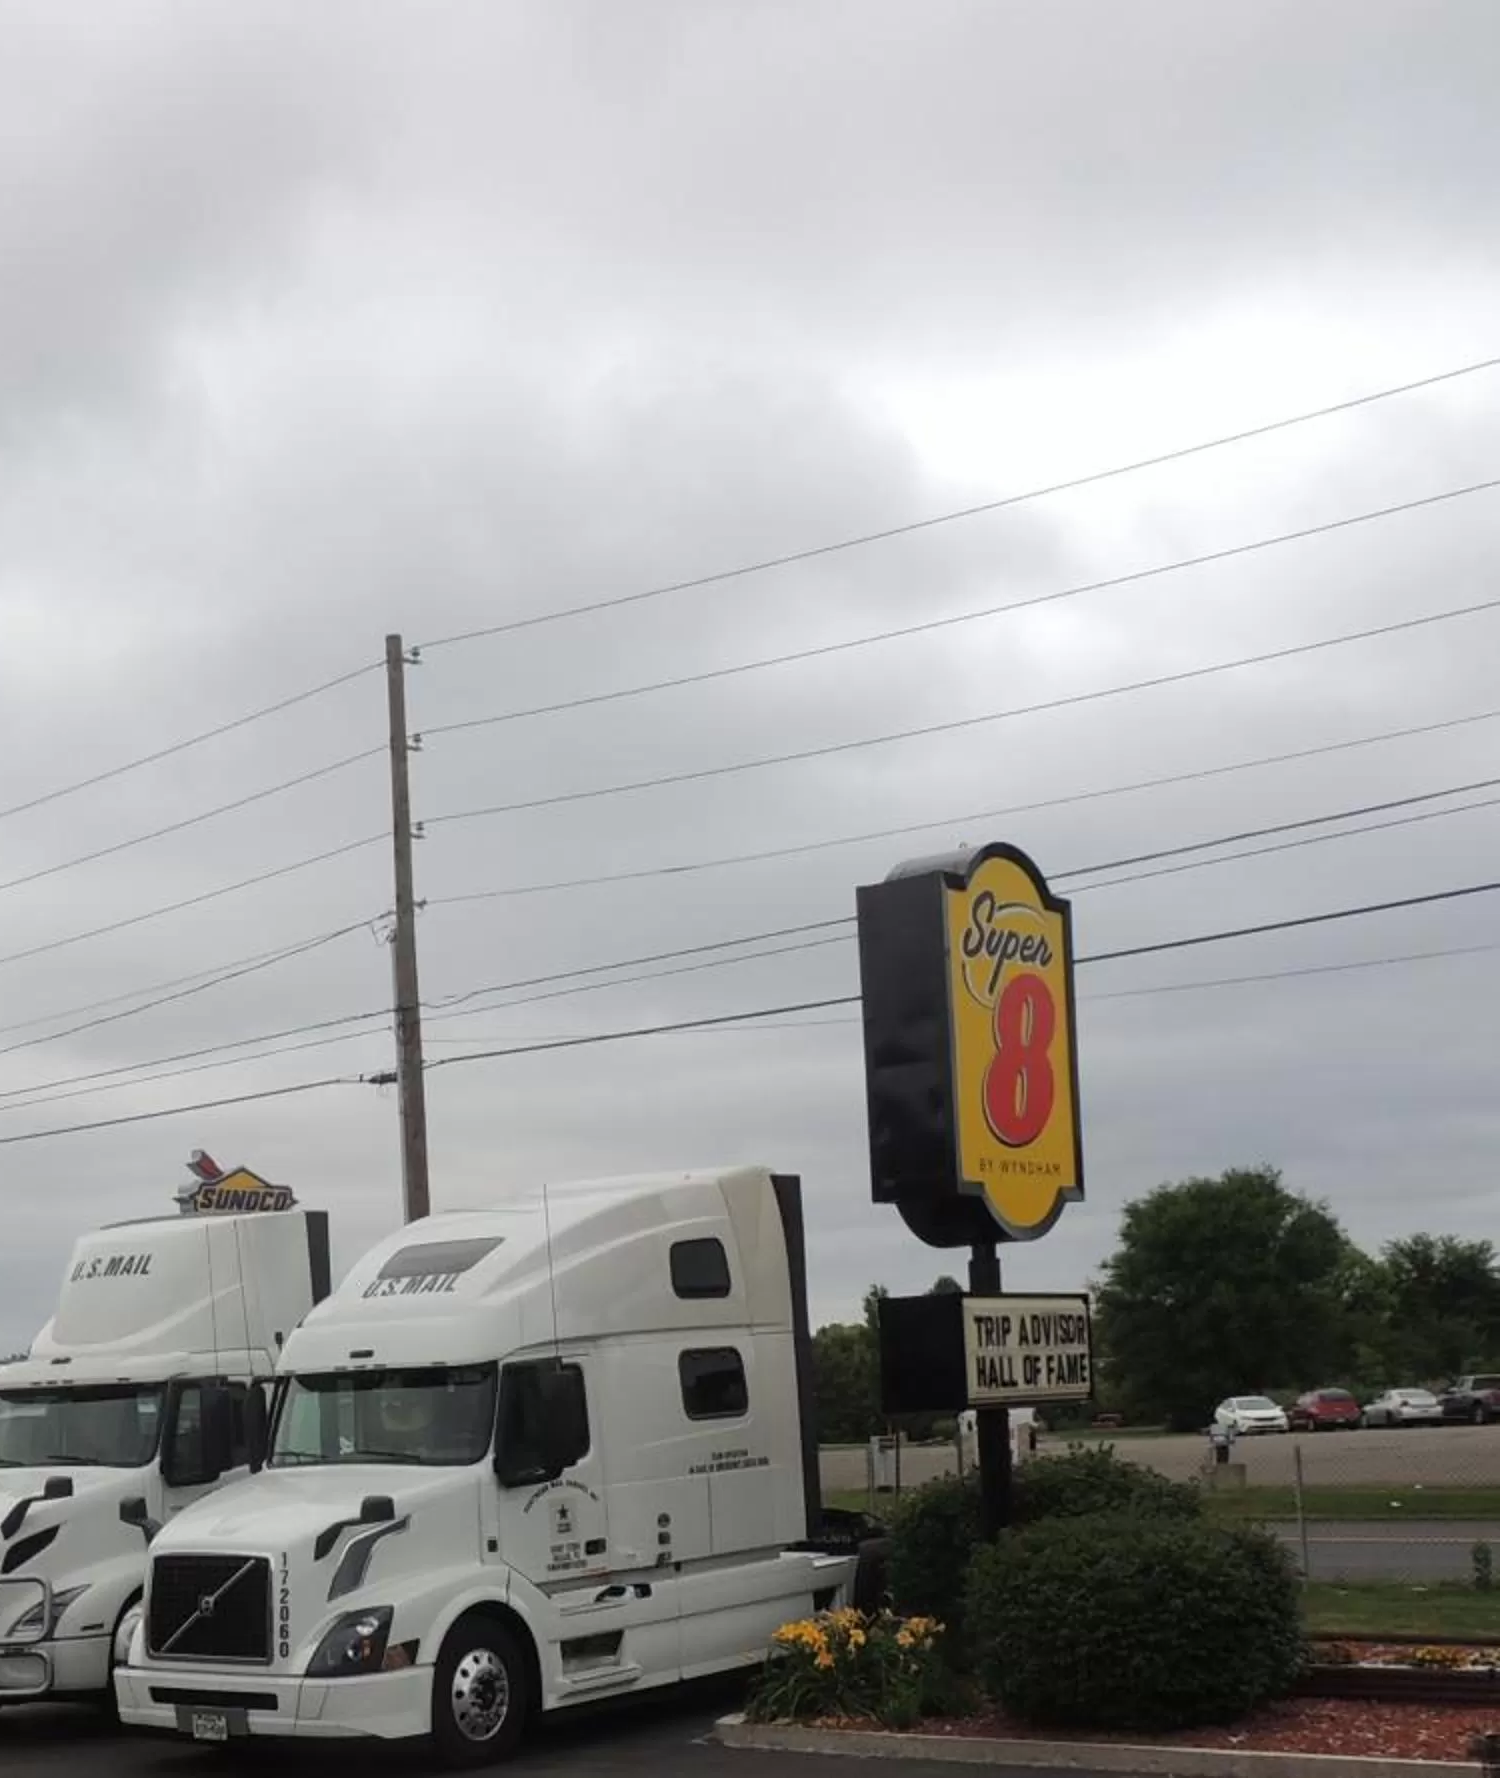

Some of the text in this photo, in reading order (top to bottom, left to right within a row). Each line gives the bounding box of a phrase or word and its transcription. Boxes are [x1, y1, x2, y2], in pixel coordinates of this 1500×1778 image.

[963, 890, 1053, 995] Super
[982, 973, 1057, 1149] 8
[979, 1157, 1062, 1177] BY WYNDHAM
[200, 1188, 289, 1212] SUNOCO
[973, 1313, 1087, 1348] TRIP ADVISOR
[975, 1353, 1088, 1389] HALL OF FAME
[279, 1551, 290, 1659] 172060
